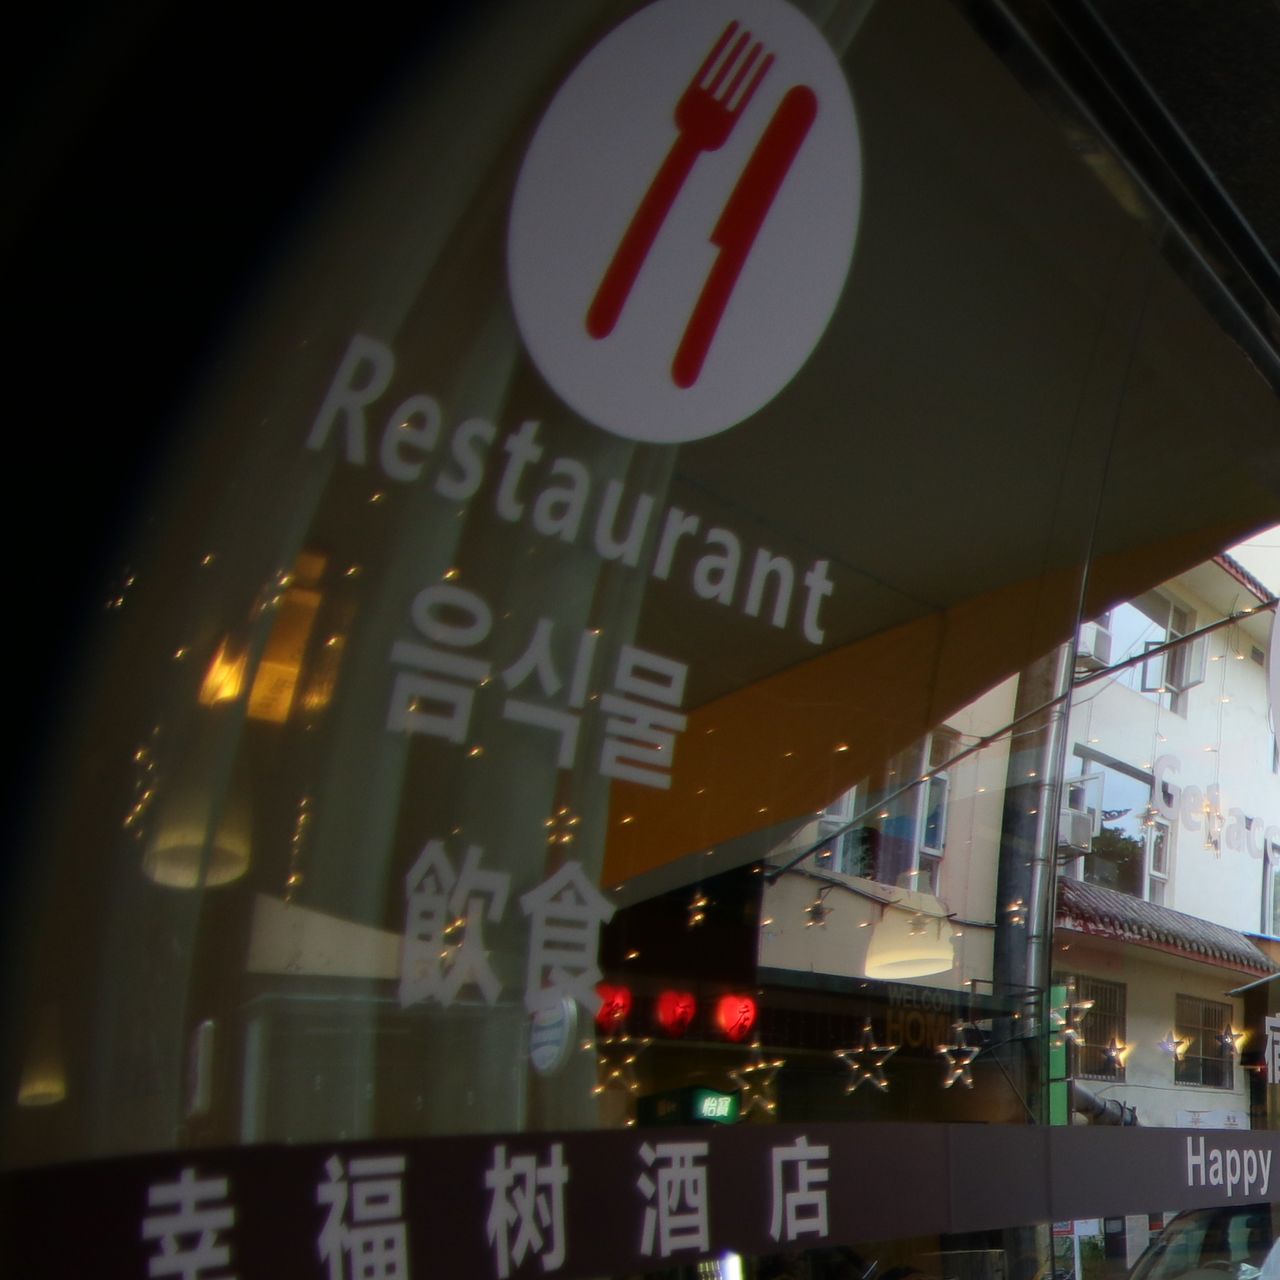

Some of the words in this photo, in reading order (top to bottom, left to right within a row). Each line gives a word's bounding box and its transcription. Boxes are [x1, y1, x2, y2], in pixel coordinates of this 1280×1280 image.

[306, 334, 834, 644] Restaurant
[387, 585, 689, 790] 음식물
[397, 839, 617, 1015] 飲食
[1187, 1136, 1272, 1196] Happy
